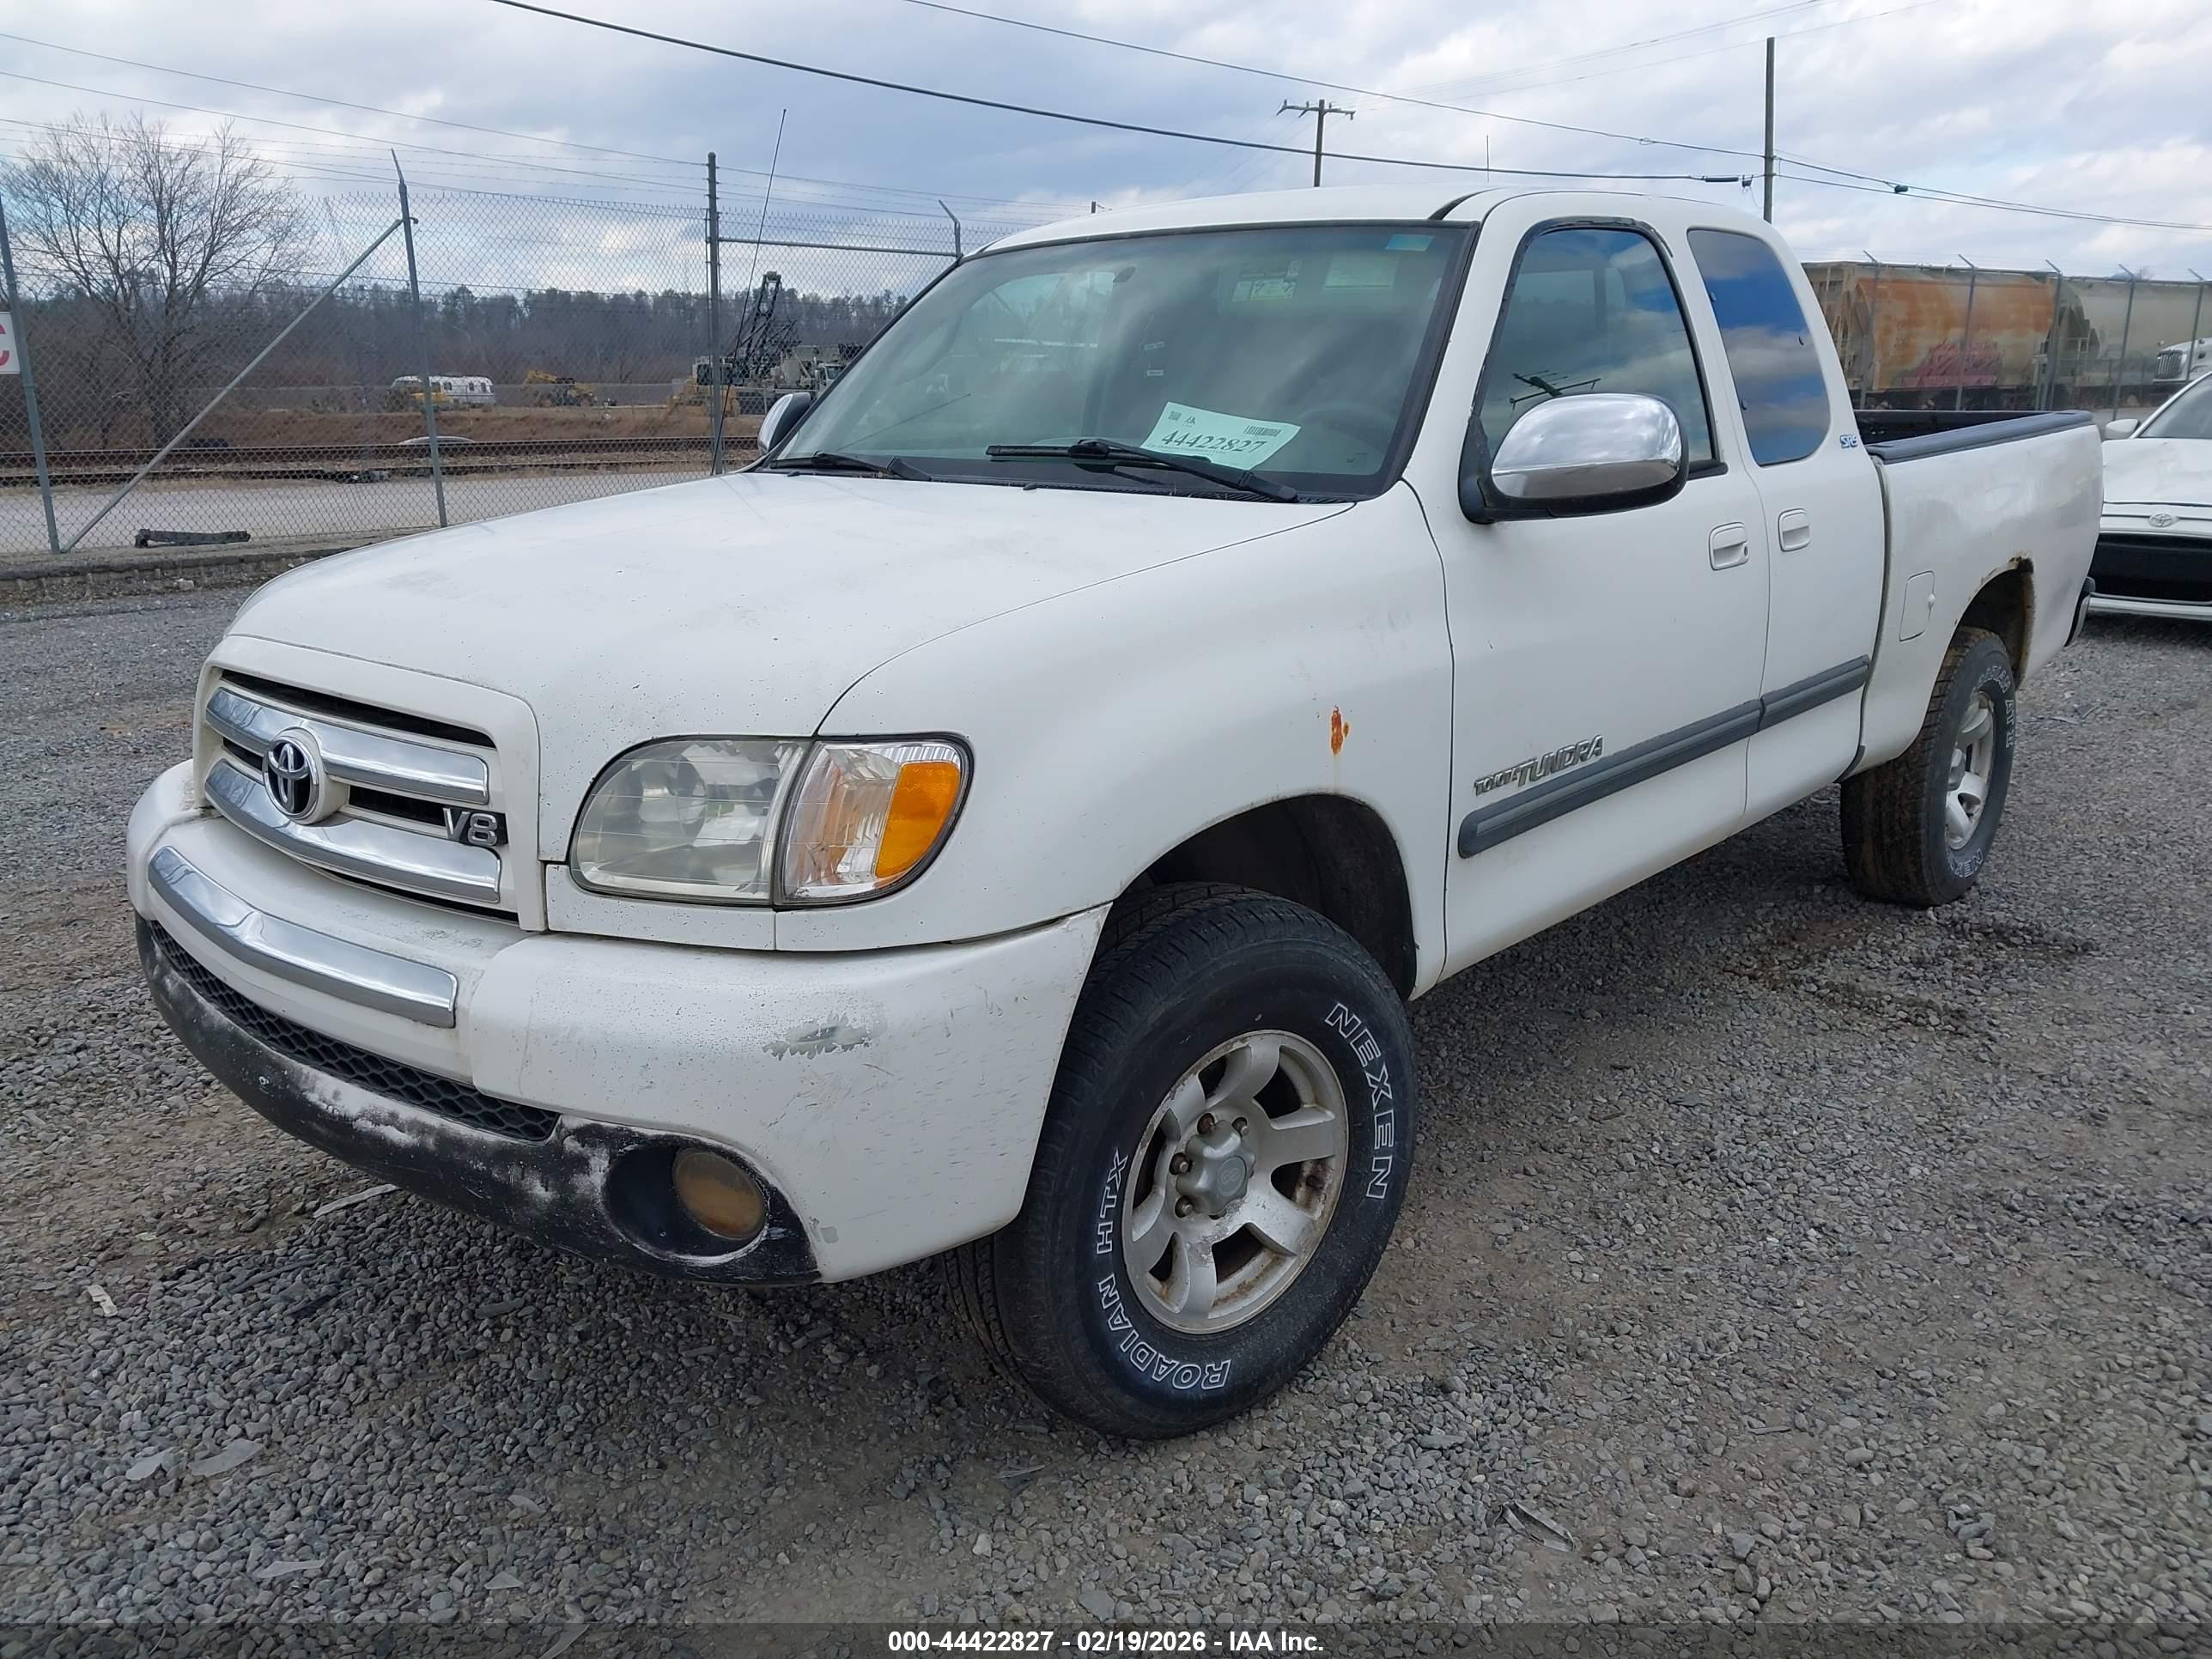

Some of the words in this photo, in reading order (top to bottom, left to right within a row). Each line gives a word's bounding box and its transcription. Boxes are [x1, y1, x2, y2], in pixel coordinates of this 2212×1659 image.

[1161, 430, 1267, 453] 44422827
[1474, 767, 1518, 797] TOYOTA
[1513, 734, 1604, 787] TUNDRA
[443, 807, 498, 847] V8
[1324, 1003, 1395, 1200] NEXEN
[1097, 1147, 1129, 1255] HTX
[1098, 1273, 1231, 1390] ROADIAN
